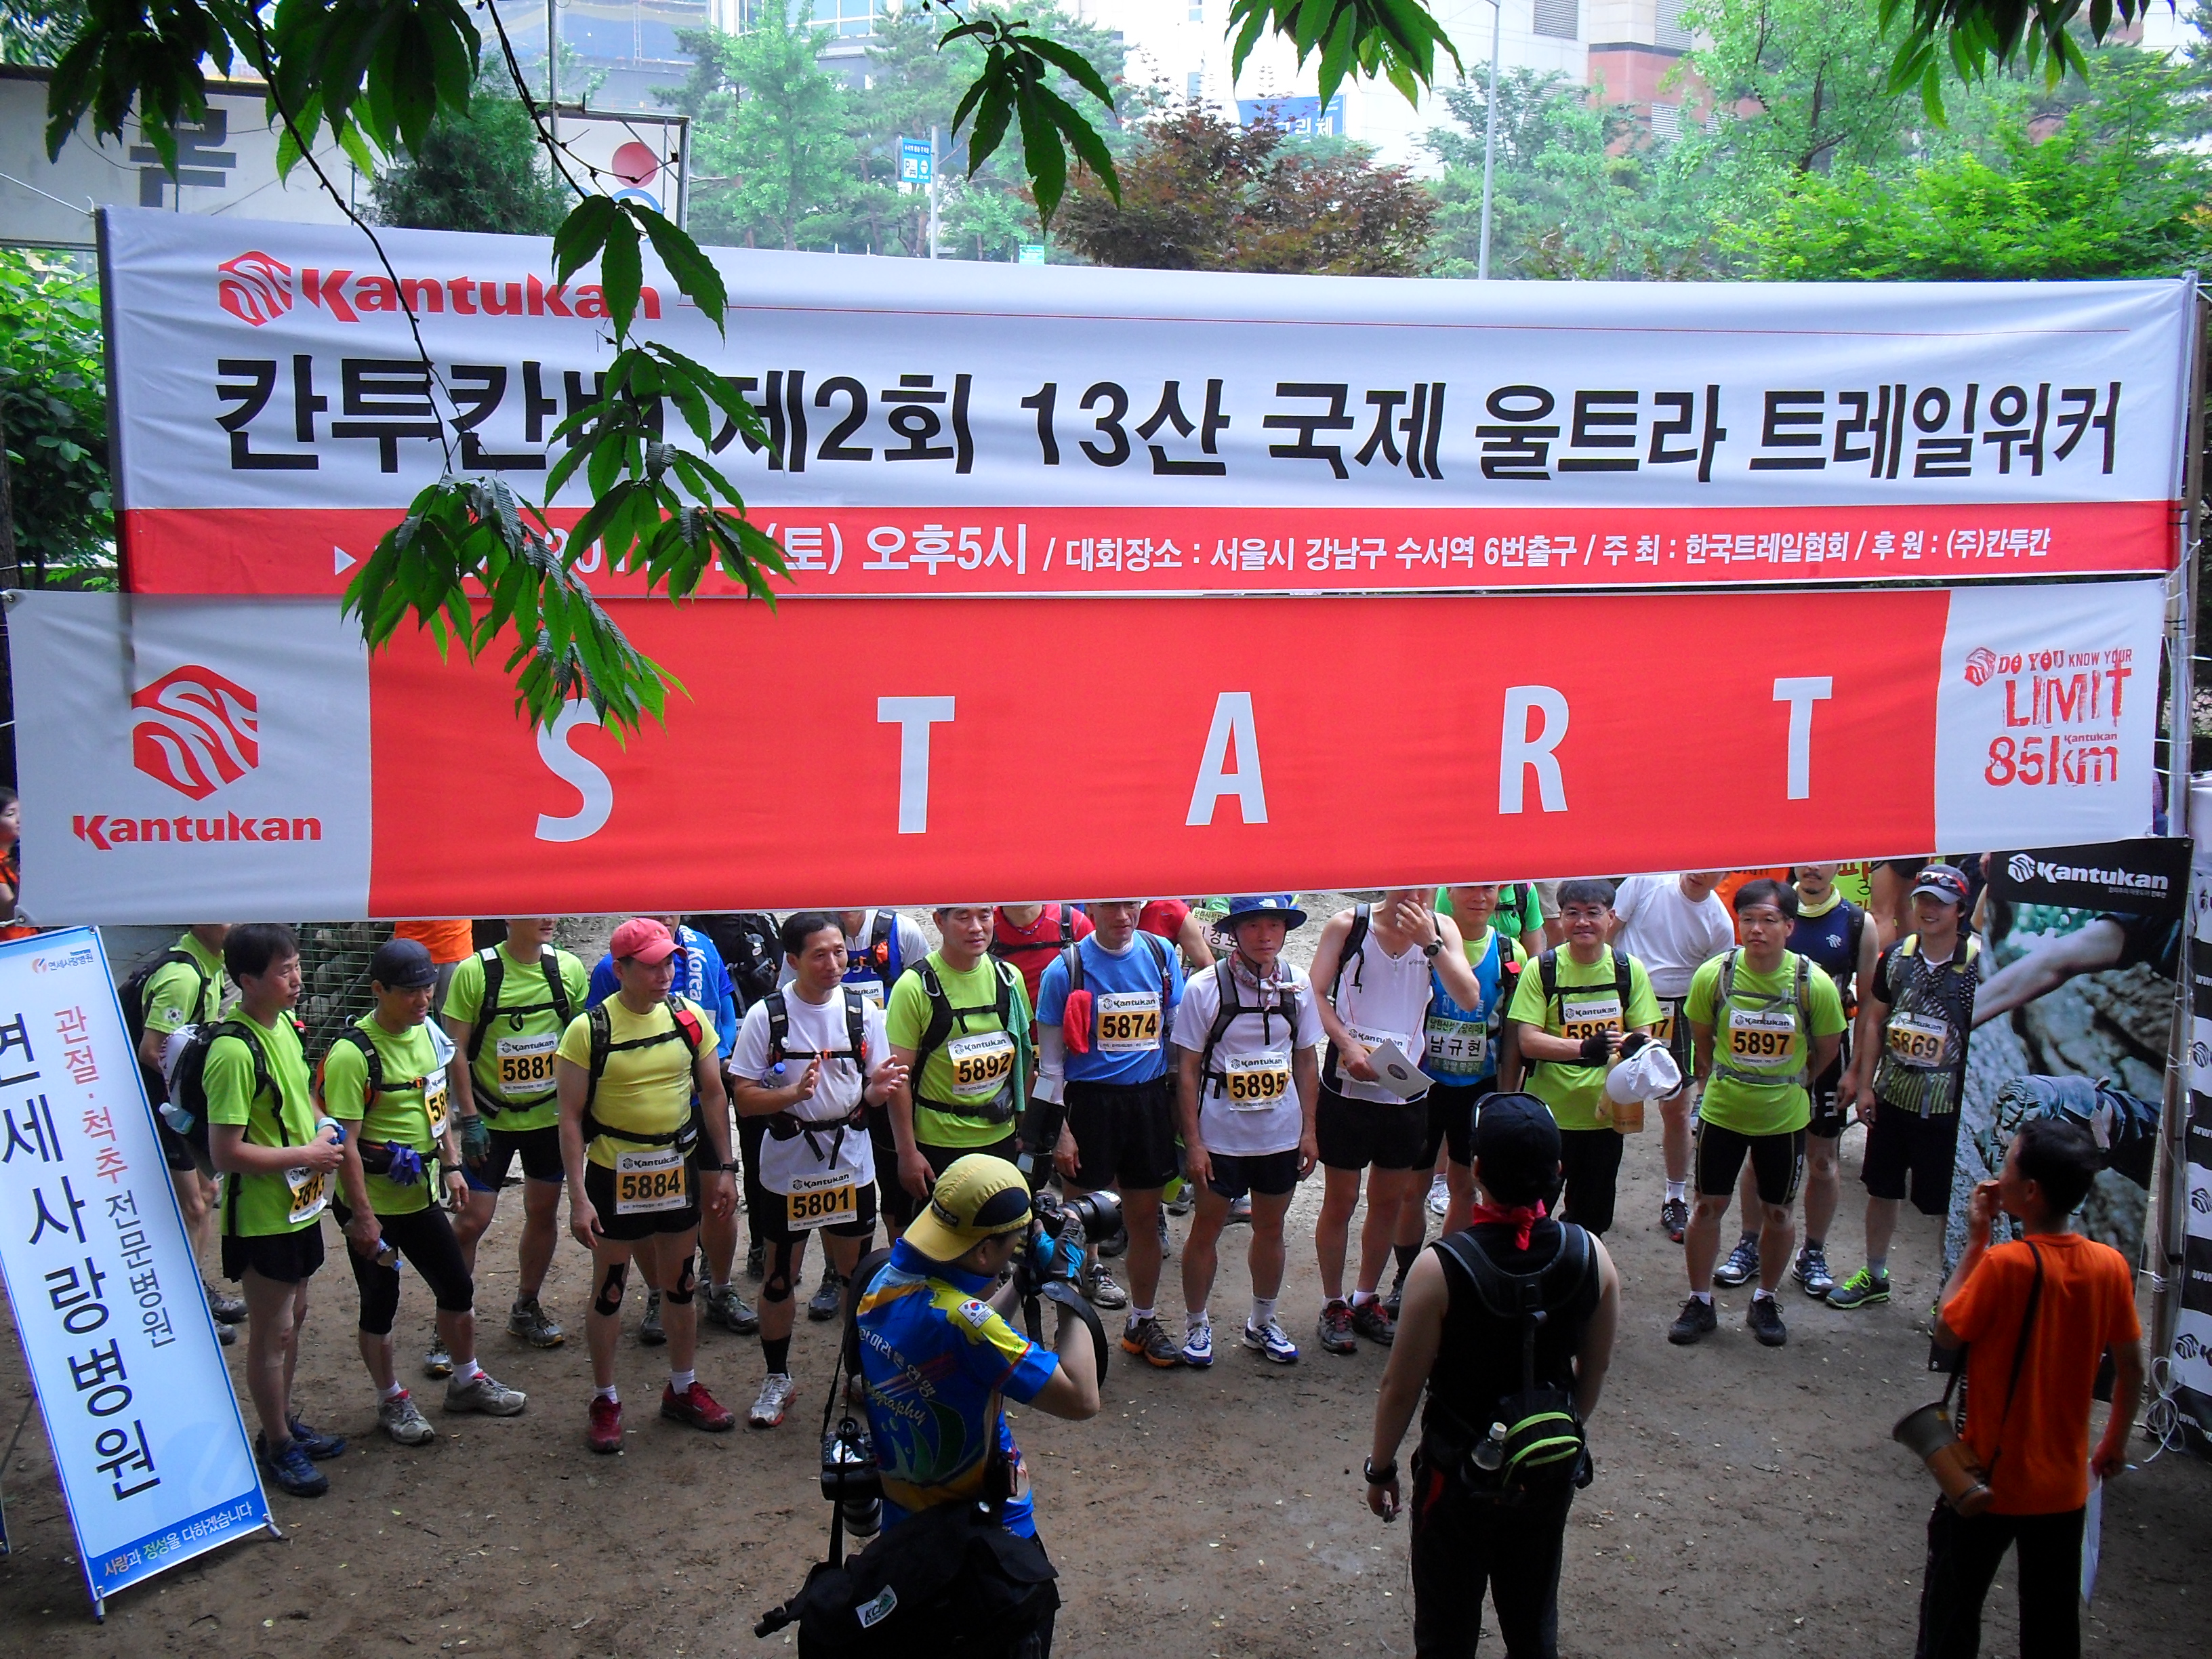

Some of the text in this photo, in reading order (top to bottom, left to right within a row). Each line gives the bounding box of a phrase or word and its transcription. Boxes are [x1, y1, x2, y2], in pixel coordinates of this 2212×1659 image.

[302, 268, 661, 323] Kantukan
[709, 369, 972, 475] 제2회
[1020, 377, 1231, 477] 13산
[1262, 382, 1447, 480] 국제
[1475, 384, 1727, 483] 울트라
[1748, 382, 2122, 480] 트레일워커
[862, 523, 1028, 576] 오후5시
[1066, 537, 1183, 573] 대회장소
[1210, 537, 1295, 572] 서울시
[1305, 537, 1387, 571] 강남구
[1395, 535, 1475, 569] 수서역
[1483, 534, 1578, 568] 6번출구
[1685, 531, 1850, 564] 한국트레일협회
[1946, 528, 2051, 560] (주)칸투칸
[1996, 648, 2133, 674] DO YOU KNOW YOUR
[2004, 668, 2133, 729] LIMIT
[2064, 732, 2118, 744] Kantukan
[1984, 735, 2119, 787] 85km
[72, 811, 322, 850] Kantukan
[2036, 861, 2169, 890] Kantukan
[687, 946, 708, 1002] Korea
[1102, 1012, 1156, 1039] 5874
[1429, 1035, 1481, 1057] 남규현
[1734, 1031, 1790, 1055] 5897
[1891, 1029, 1938, 1059] 5869
[503, 1053, 554, 1082] 5881
[958, 1052, 1011, 1083] 5892
[1232, 1071, 1286, 1099] 5895
[622, 1169, 681, 1200] 5884
[792, 1187, 849, 1218] 5801
[104, 1189, 177, 1349] 전문병원
[104, 1500, 253, 1577] 사랑과 정성을 다하겠습니다
